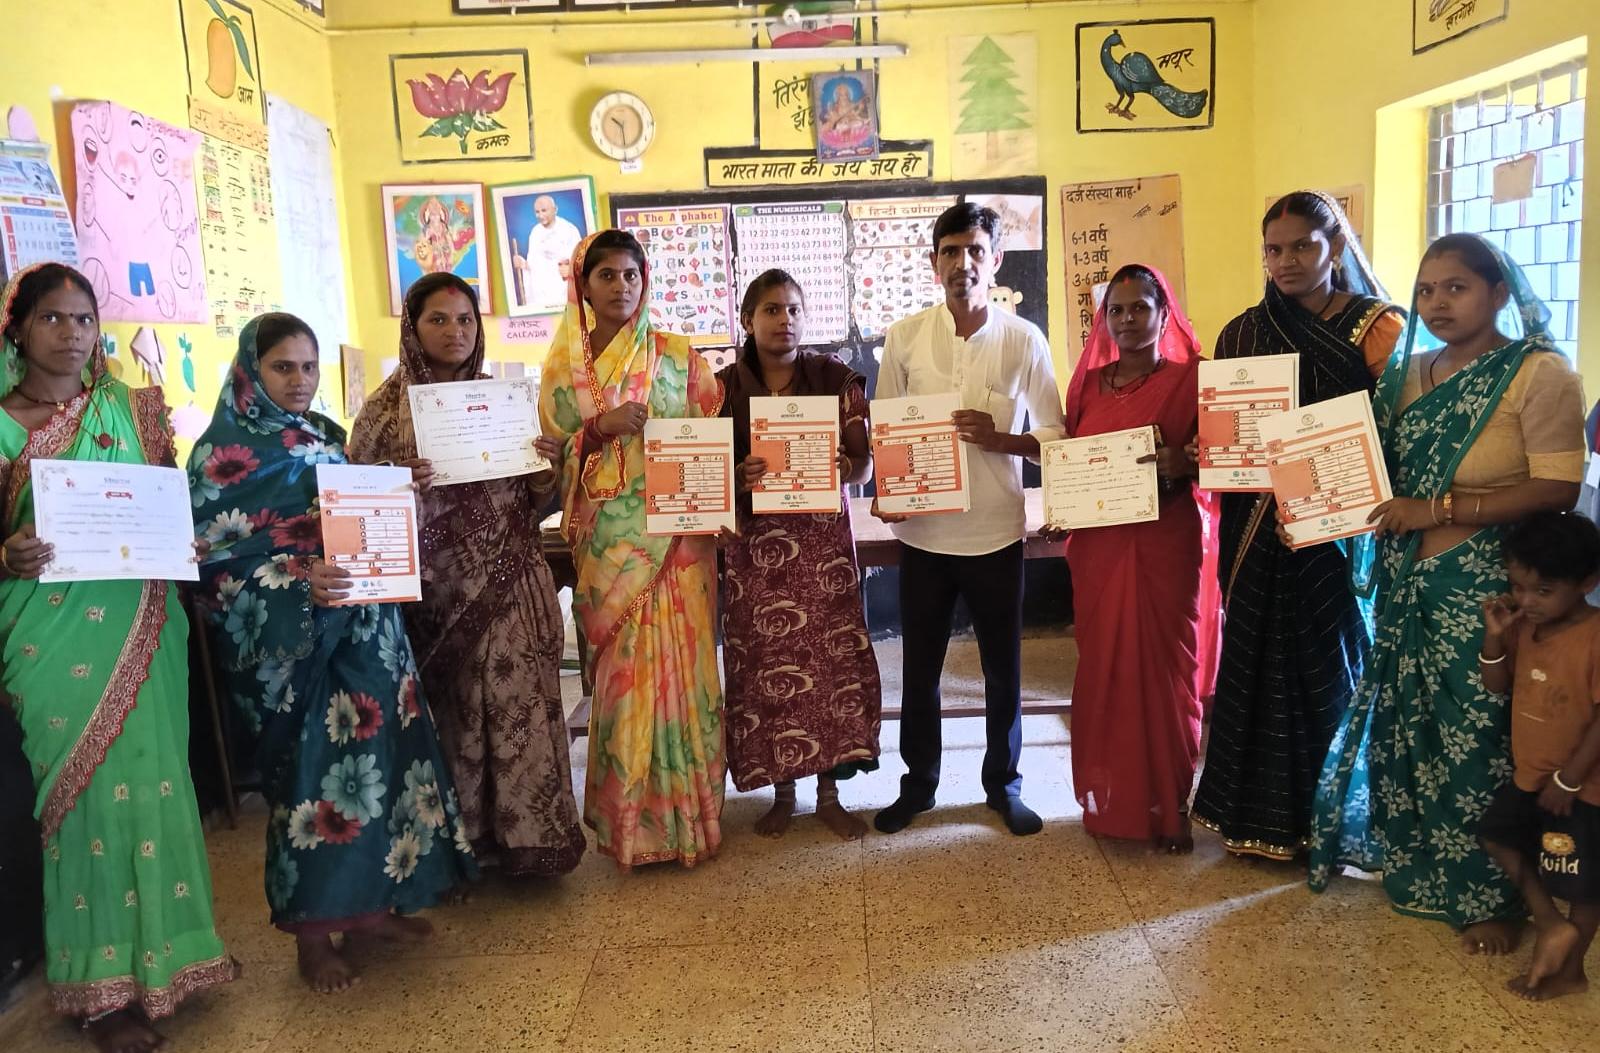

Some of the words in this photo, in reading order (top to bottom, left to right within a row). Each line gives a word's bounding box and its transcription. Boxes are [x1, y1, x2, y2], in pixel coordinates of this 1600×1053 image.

[1156, 48, 1194, 73] मयूर
[237, 86, 254, 105] आम
[772, 76, 810, 109] तिरंग
[475, 134, 511, 150] कमल
[722, 163, 757, 179] भारत
[761, 162, 795, 178] माता
[832, 161, 862, 176] जय
[870, 158, 899, 175] जय
[901, 153, 921, 177] हो
[1066, 182, 1084, 203] दर्ज
[773, 205, 822, 213] NUMERICALS
[869, 205, 896, 216] हिन्दी
[644, 213, 664, 223] The
[669, 211, 718, 222] Aphabet
[651, 228, 659, 236] B
[676, 226, 684, 235] C
[700, 225, 709, 234] D
[750, 230, 758, 238] 12
[801, 228, 810, 236] 62
[652, 244, 659, 253] F
[677, 243, 686, 252] G
[701, 241, 710, 250] H
[678, 259, 686, 268] K
[702, 258, 709, 266] L
[654, 275, 663, 284] N
[679, 274, 688, 283] O
[703, 273, 711, 282] P
[656, 291, 664, 300] R
[680, 290, 688, 299] S
[704, 289, 712, 298] T
[665, 307, 673, 315] V
[697, 305, 708, 313] W
[666, 322, 674, 331] Y
[698, 321, 706, 330] Z
[506, 330, 548, 339] CALENDAR
[1540, 852, 1580, 875] uild
